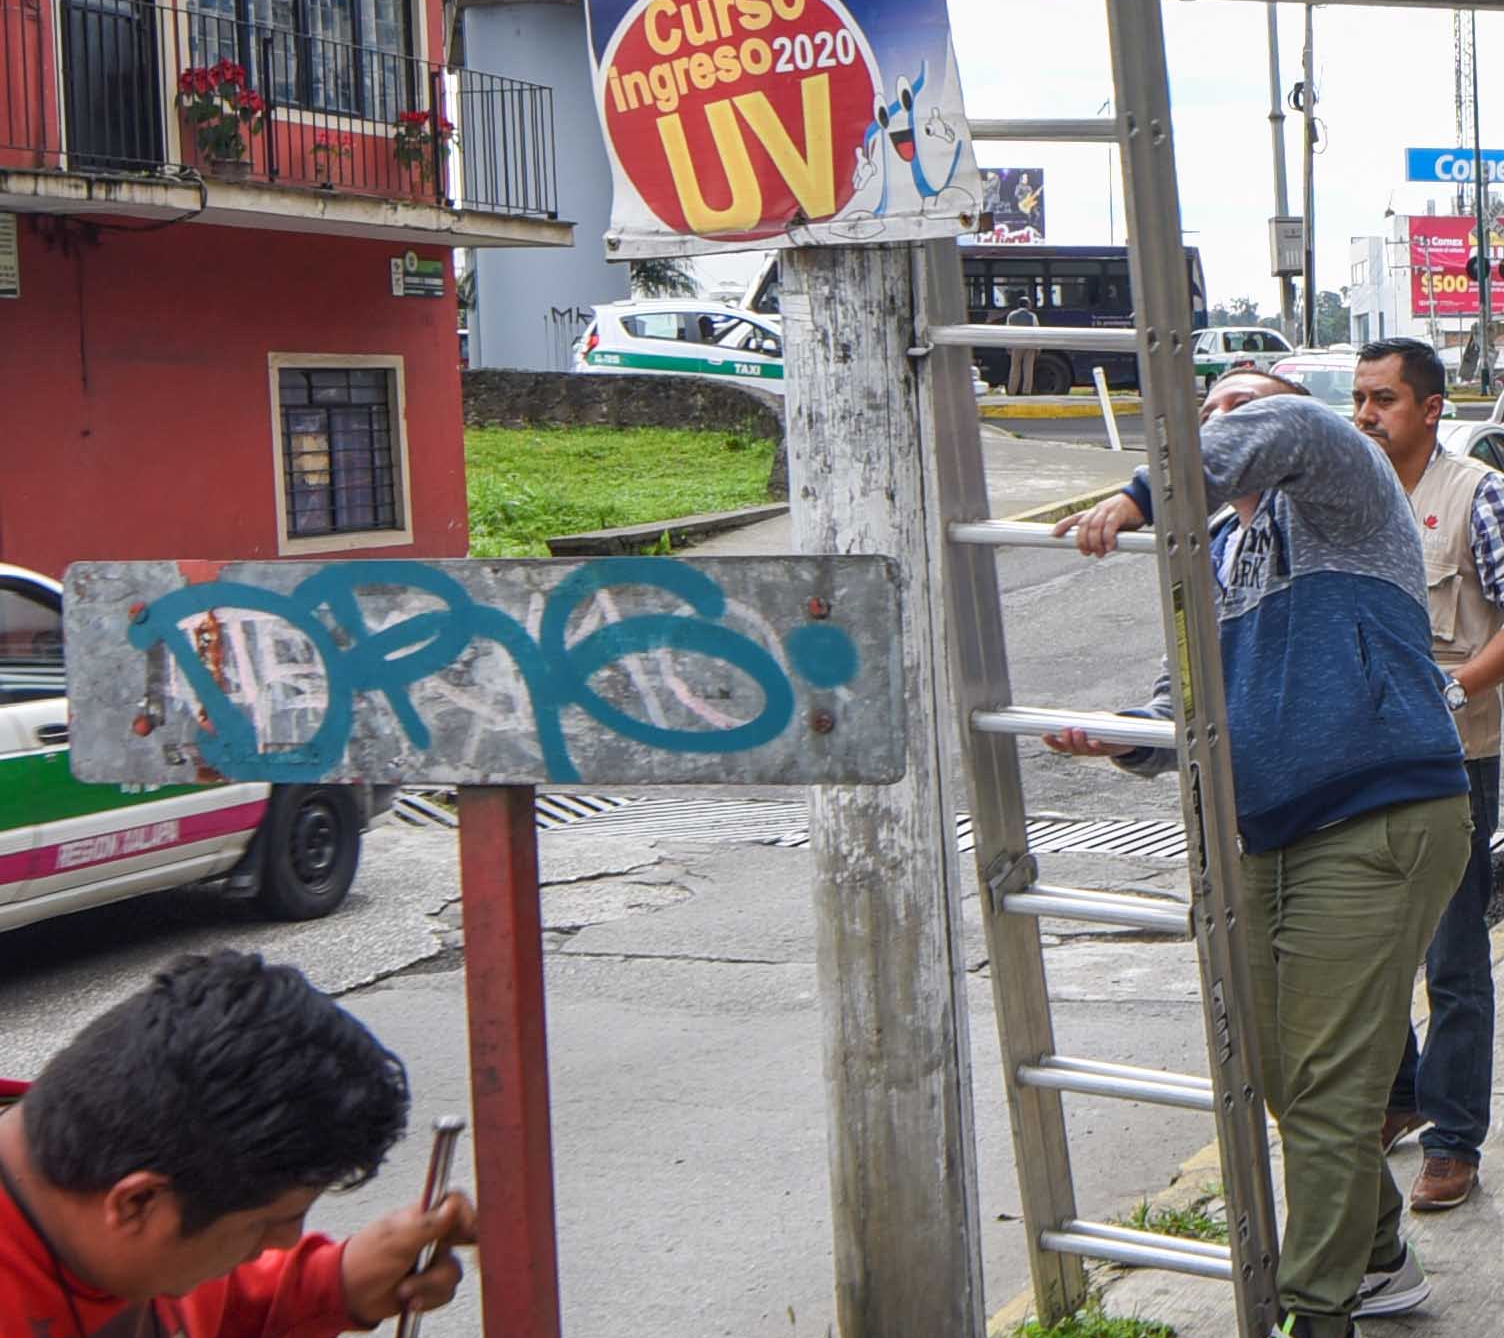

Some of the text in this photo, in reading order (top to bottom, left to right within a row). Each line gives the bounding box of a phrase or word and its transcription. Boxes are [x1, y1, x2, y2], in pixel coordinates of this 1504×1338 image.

[609, 27, 857, 115] ingreso 2020
[656, 72, 837, 235] UV
[734, 363, 762, 376] TAXI
